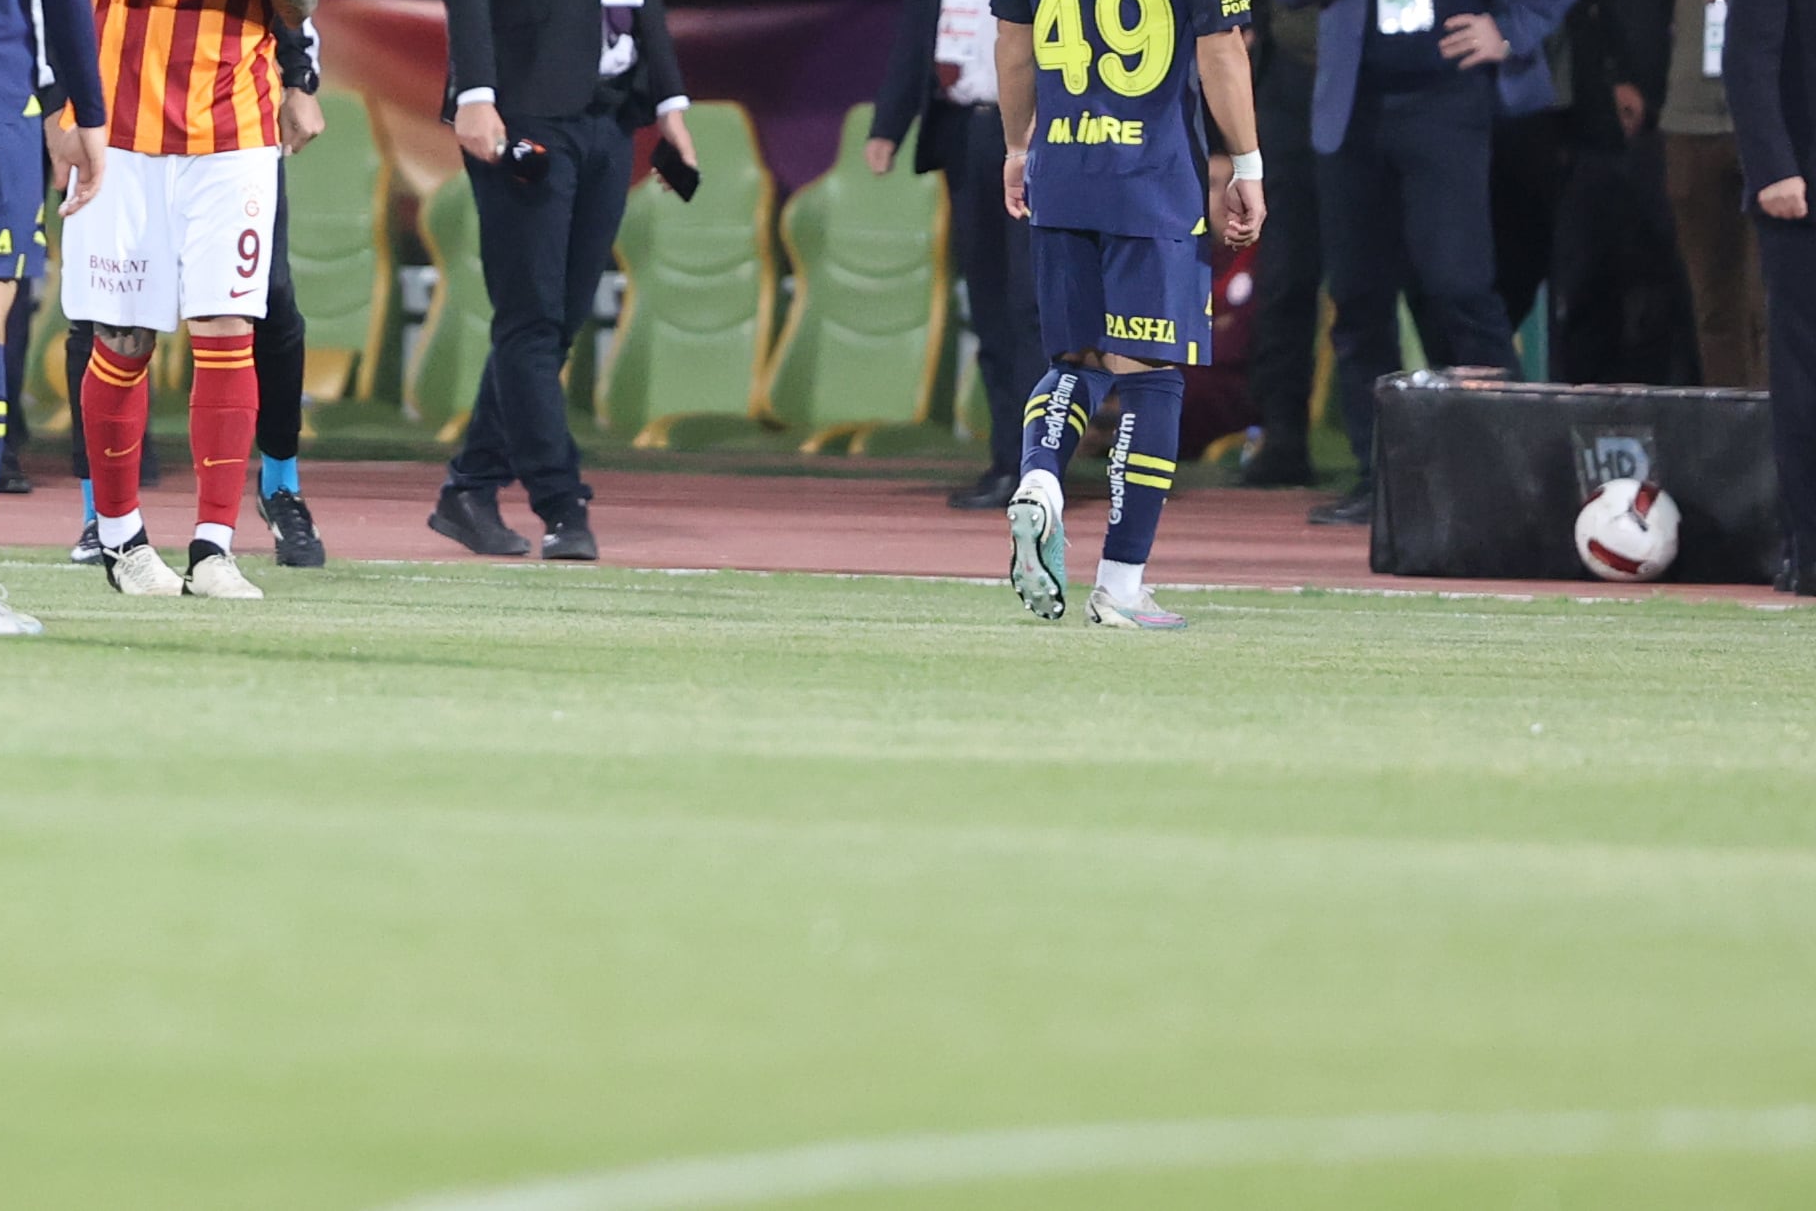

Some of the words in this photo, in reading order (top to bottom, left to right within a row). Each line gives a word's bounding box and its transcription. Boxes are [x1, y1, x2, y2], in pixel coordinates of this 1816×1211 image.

[89, 255, 150, 274] BAŞKENT
[236, 228, 261, 279] 9
[90, 272, 145, 294] İNŞAAT
[1105, 312, 1176, 345] PASHA
